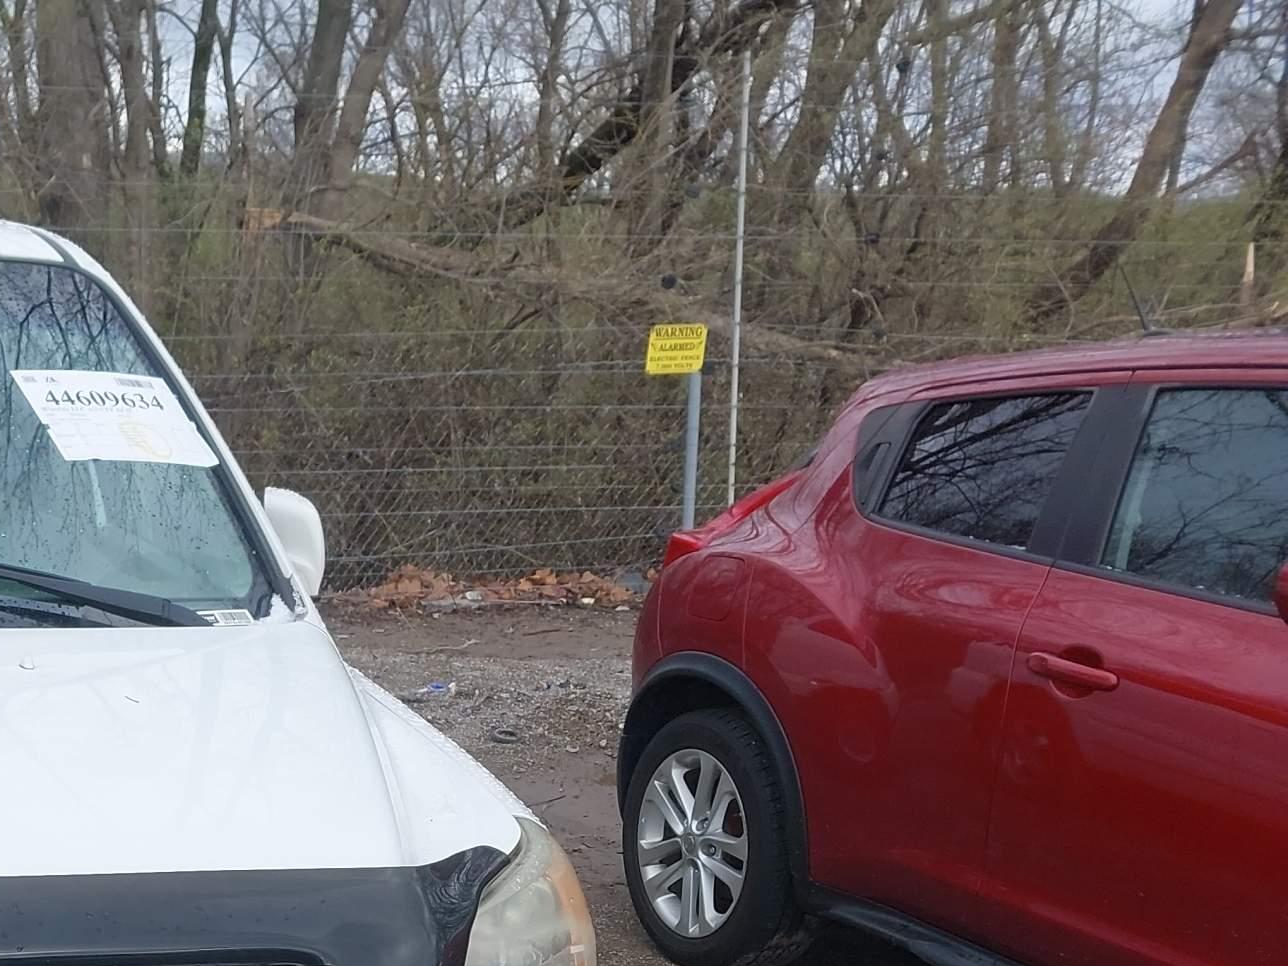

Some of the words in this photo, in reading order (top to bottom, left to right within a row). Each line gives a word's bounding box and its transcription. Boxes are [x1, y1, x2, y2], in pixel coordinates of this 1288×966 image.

[655, 326, 703, 337] WARNING
[659, 342, 696, 352] ALARMED
[44, 389, 165, 411] 44609634
